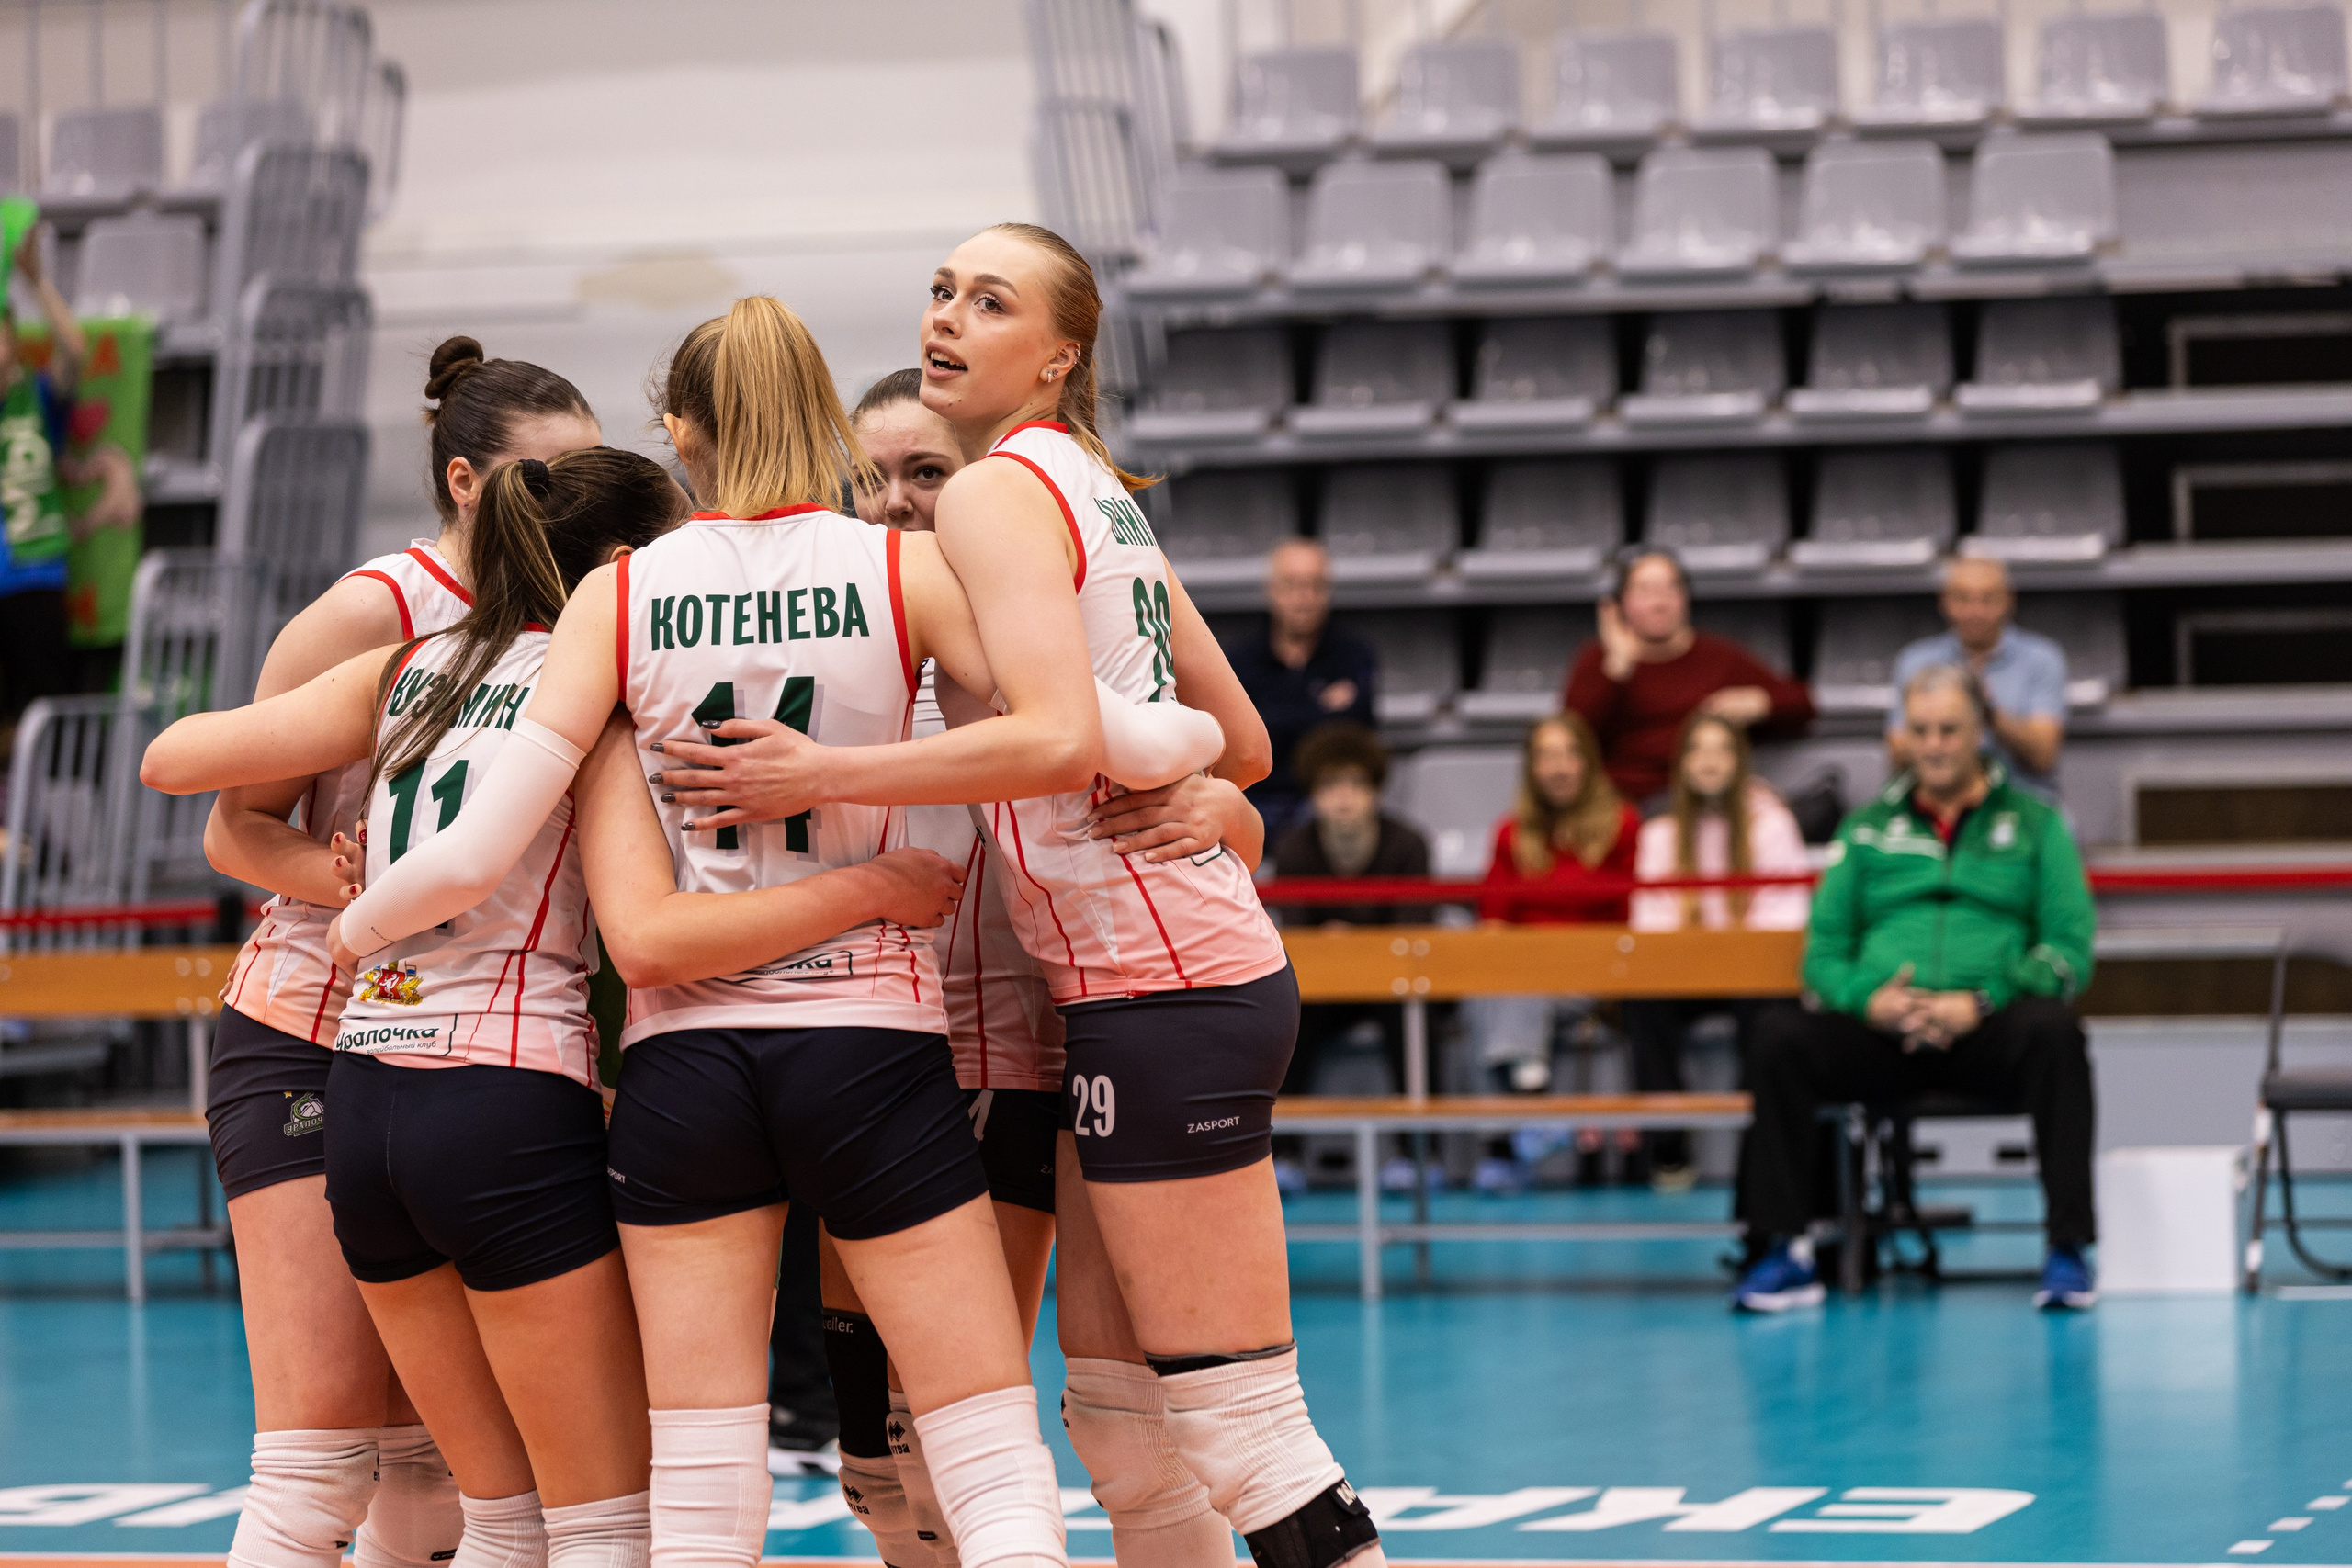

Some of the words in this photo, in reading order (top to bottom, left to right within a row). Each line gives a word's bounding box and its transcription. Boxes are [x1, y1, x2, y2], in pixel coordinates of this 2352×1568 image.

[650, 582, 870, 651] КОТЕНЕВА
[388, 757, 470, 928] 11
[1072, 1075, 1116, 1137] 29
[1187, 1115, 1240, 1134] ZASPORT
